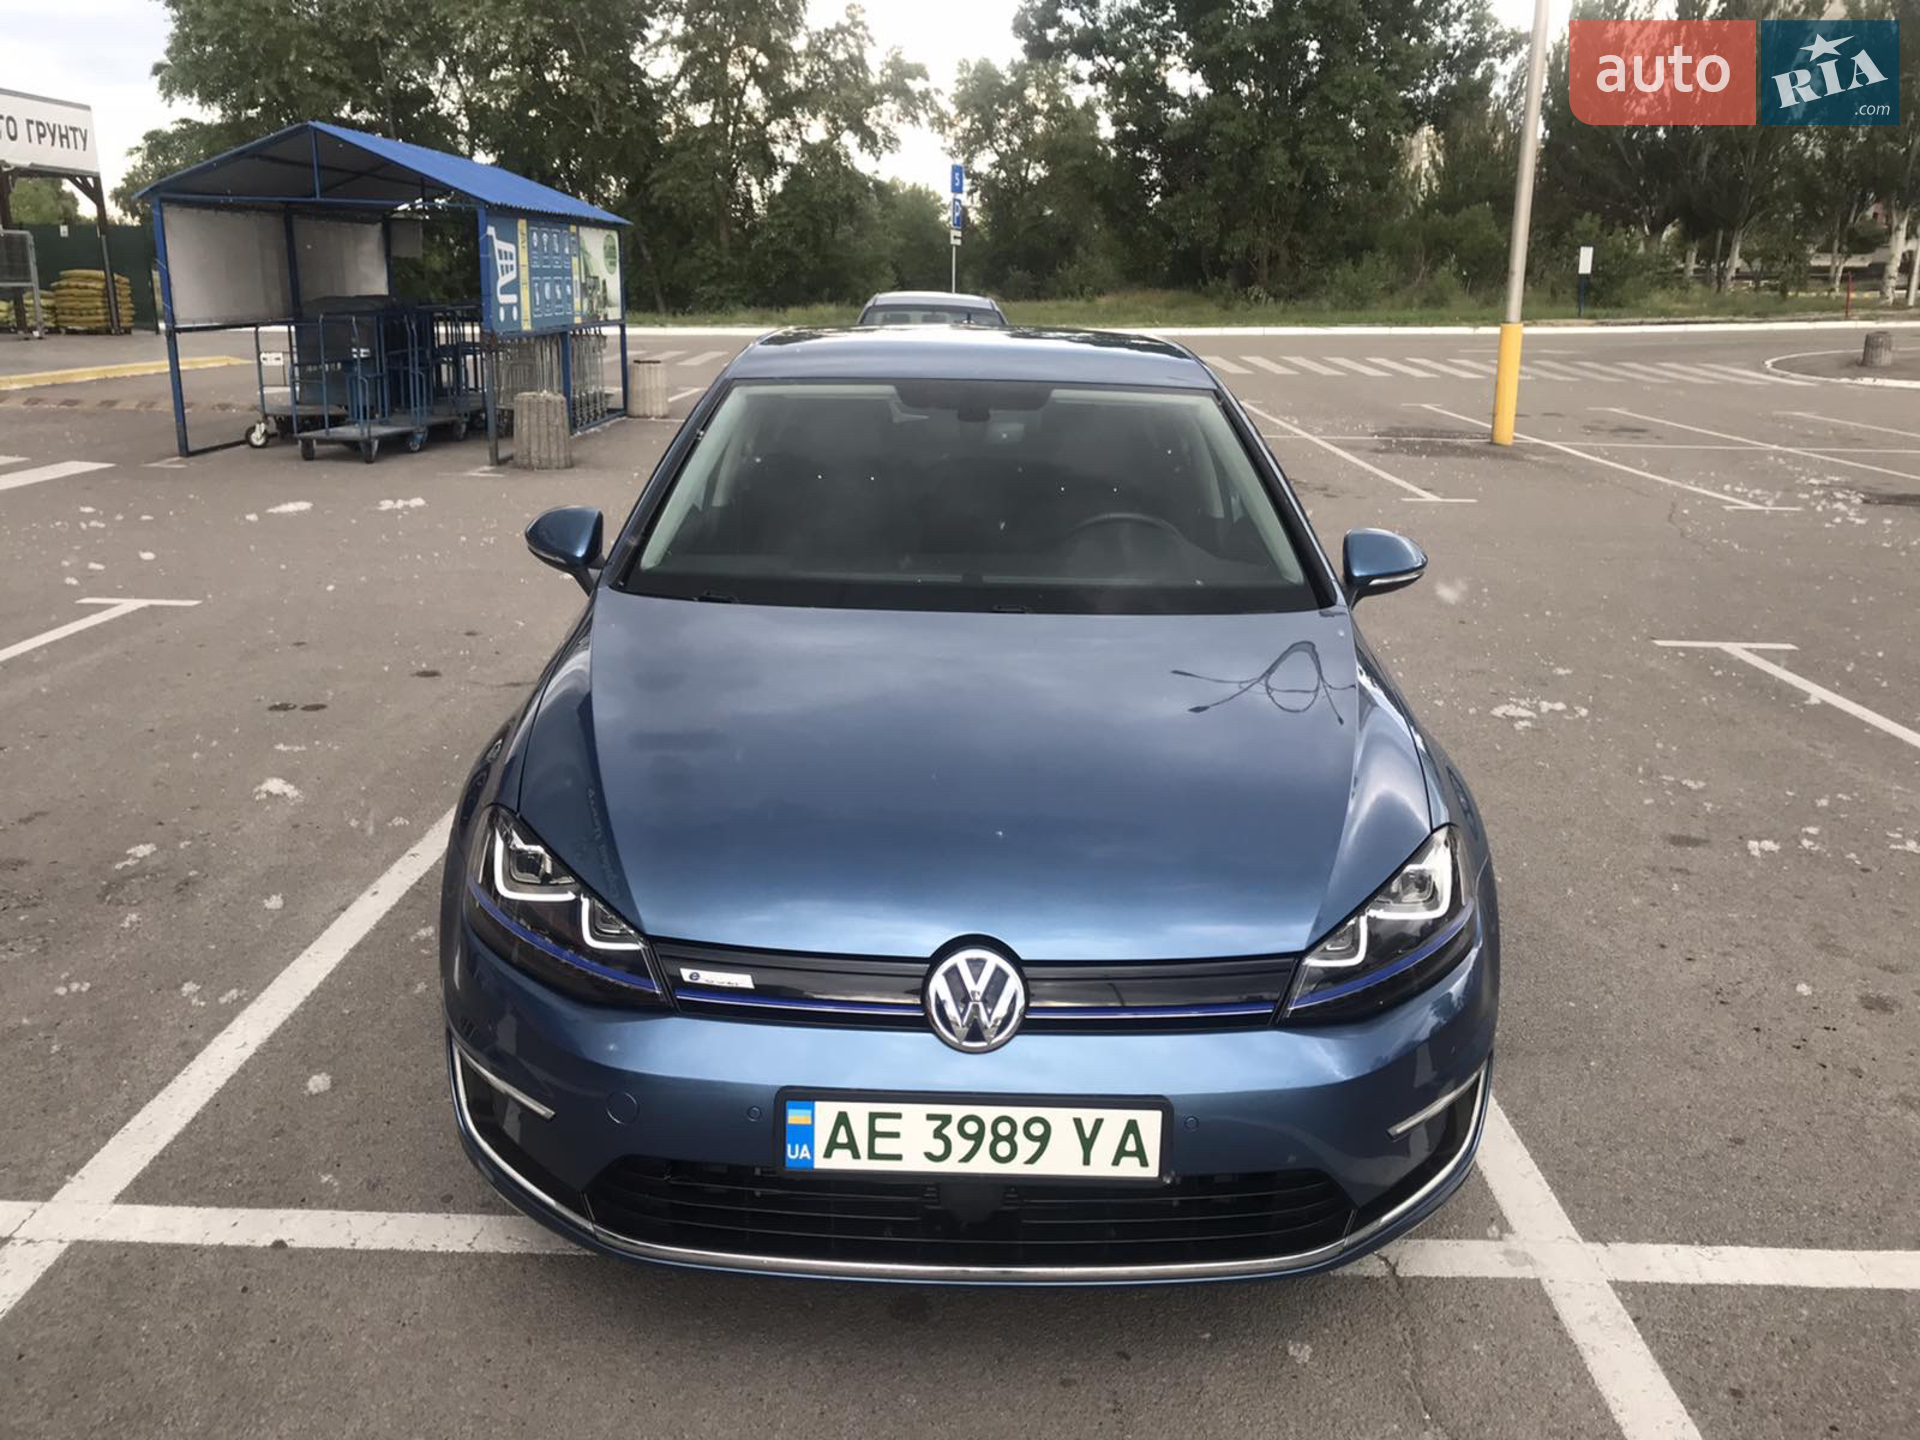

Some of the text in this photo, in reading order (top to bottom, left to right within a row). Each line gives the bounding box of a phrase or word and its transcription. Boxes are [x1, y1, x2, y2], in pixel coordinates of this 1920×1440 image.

[26, 118, 88, 152] ГРУНТУ
[787, 1143, 811, 1160] UA
[822, 1110, 1150, 1168] AE 3989 YA
